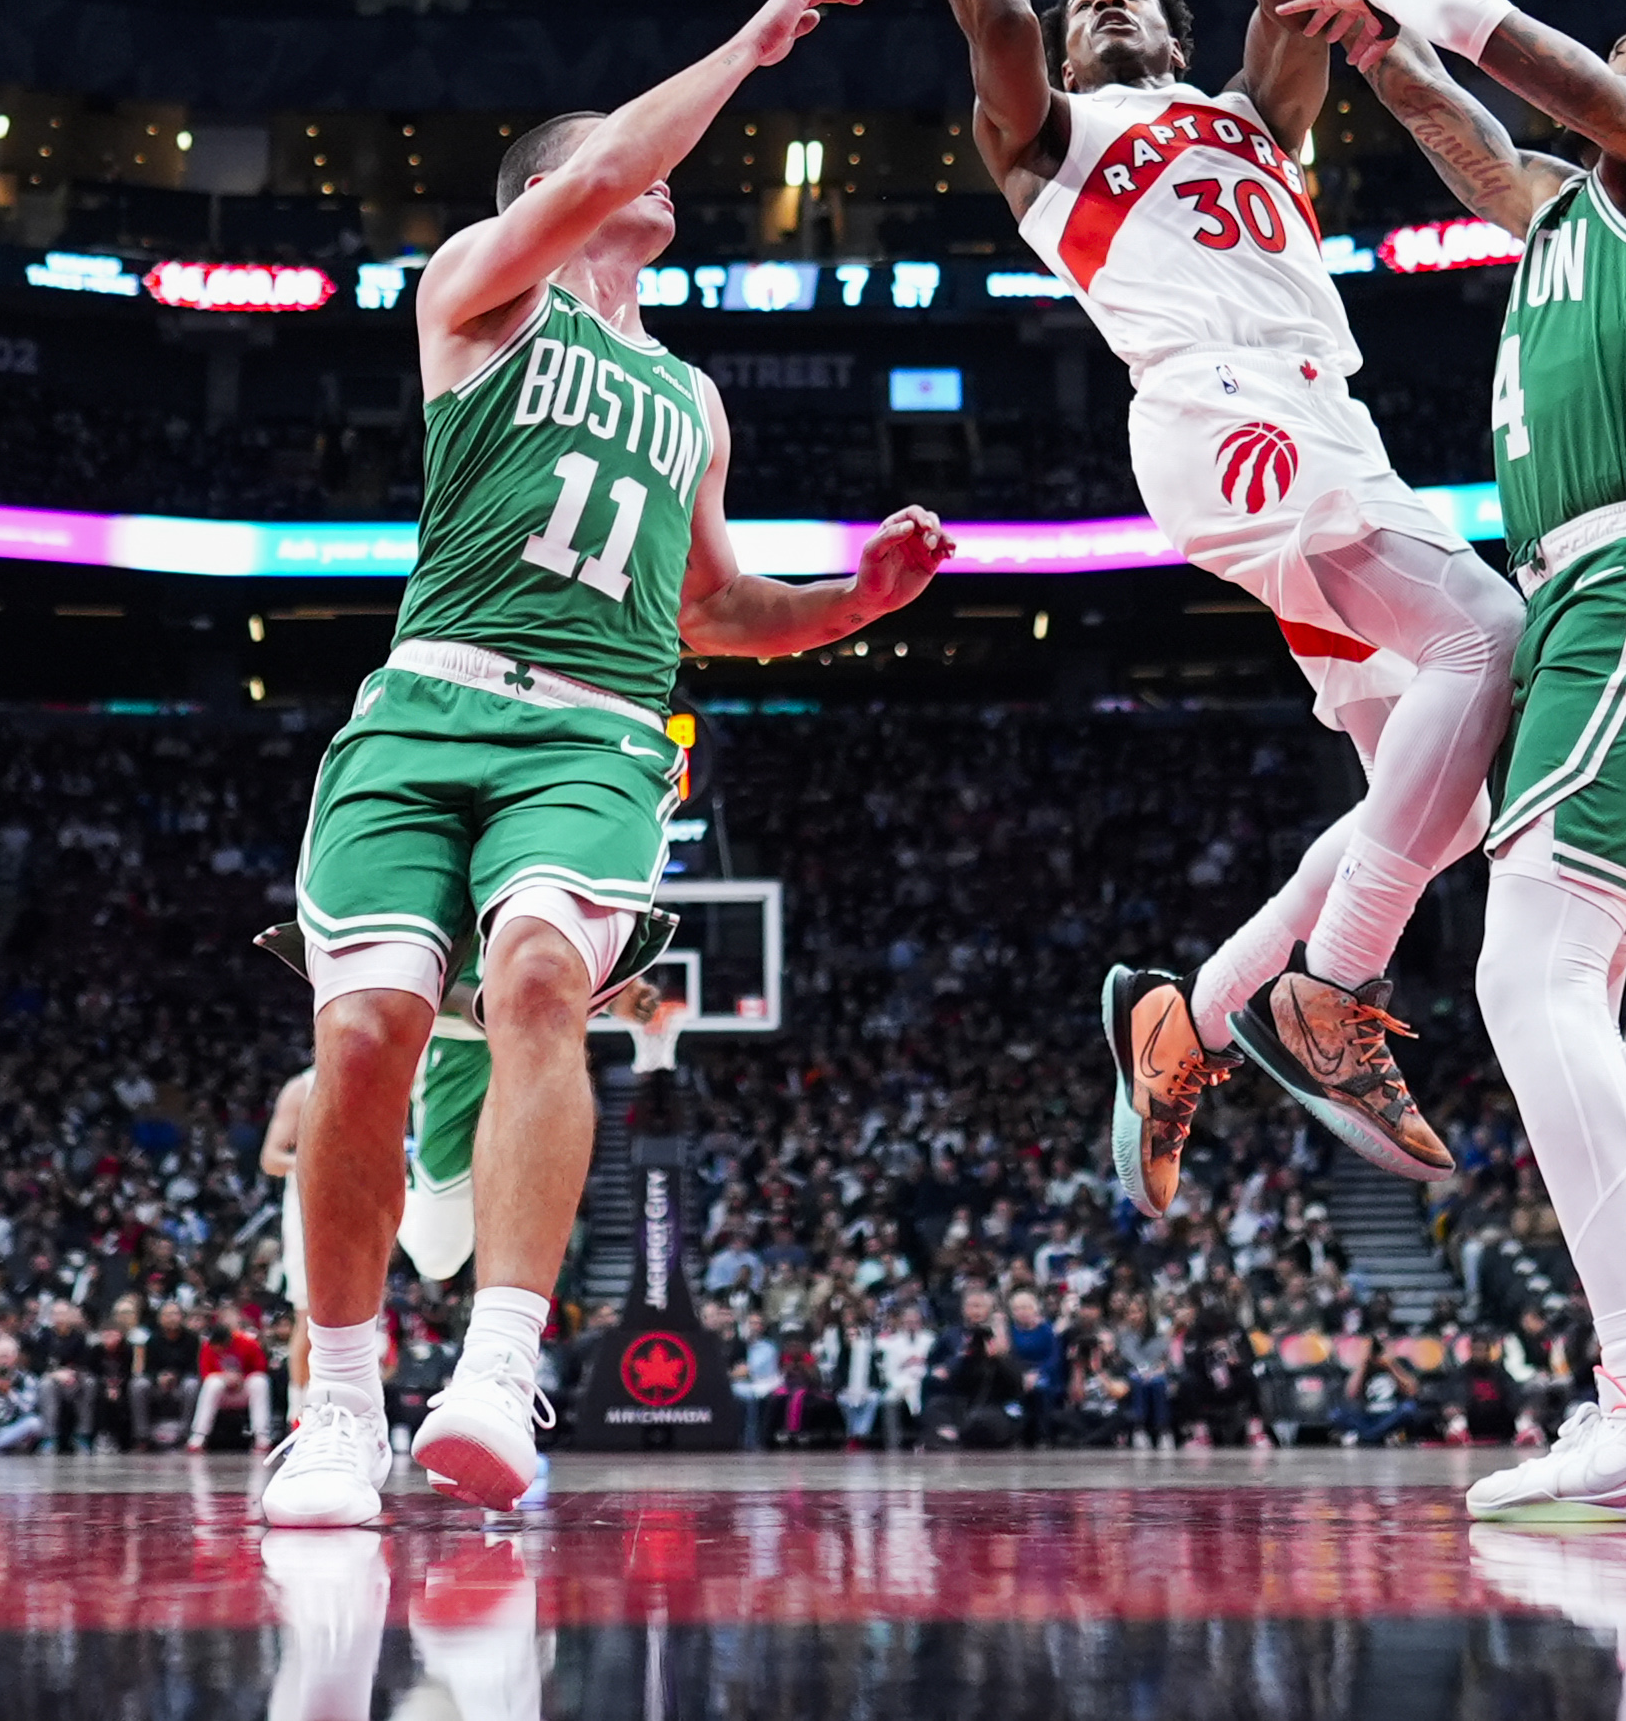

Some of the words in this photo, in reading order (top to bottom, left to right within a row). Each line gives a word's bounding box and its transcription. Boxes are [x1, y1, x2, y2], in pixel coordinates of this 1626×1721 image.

[1102, 115, 1305, 196] RAPTORS
[1402, 82, 1512, 204] Family
[1172, 177, 1287, 255] 30
[512, 337, 703, 509] BOSTON
[1491, 334, 1531, 462] 4
[521, 450, 649, 603] 11
